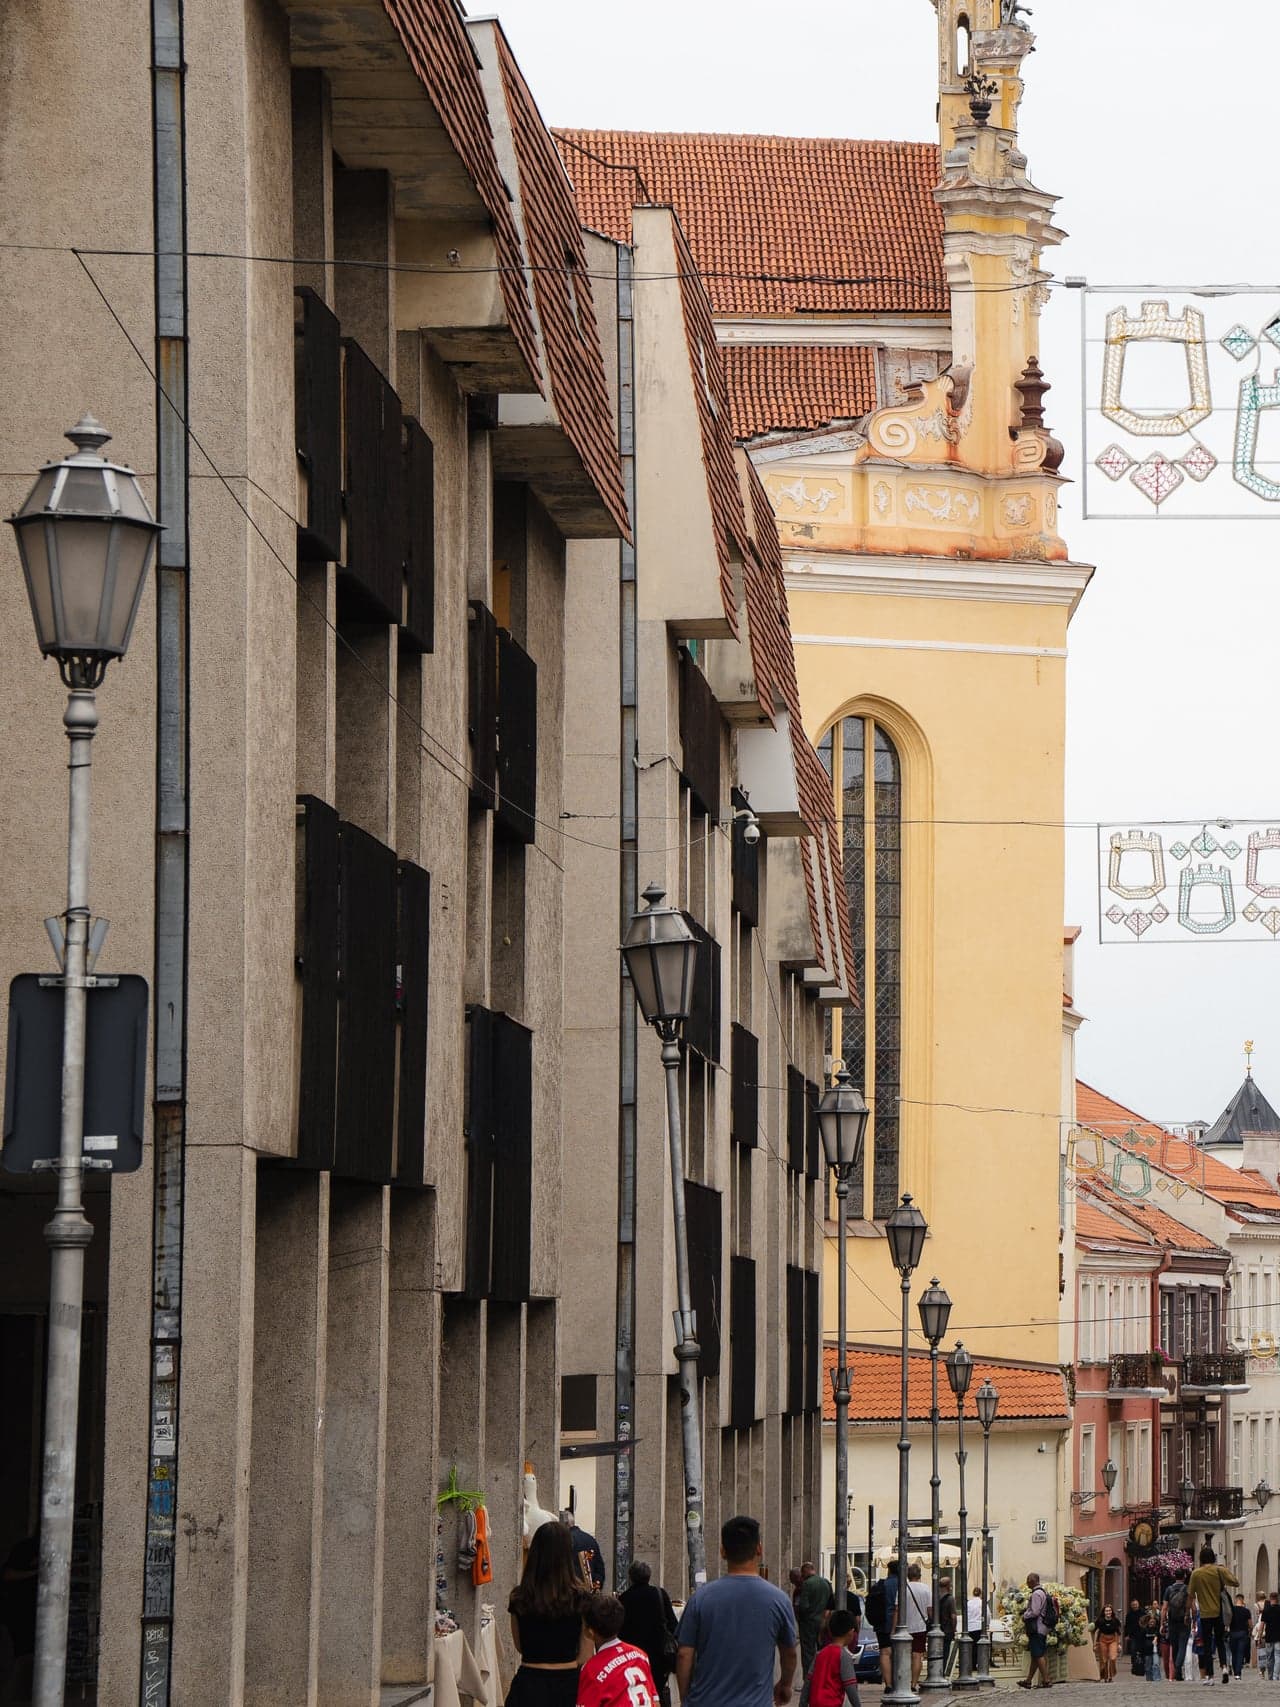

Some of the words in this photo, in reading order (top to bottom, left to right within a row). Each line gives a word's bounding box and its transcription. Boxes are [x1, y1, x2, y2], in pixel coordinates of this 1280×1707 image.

[1038, 1520, 1046, 1531] 12
[596, 1671, 607, 1683] FC
[603, 1654, 628, 1674] BAYERN
[624, 1667, 652, 1707] 6
